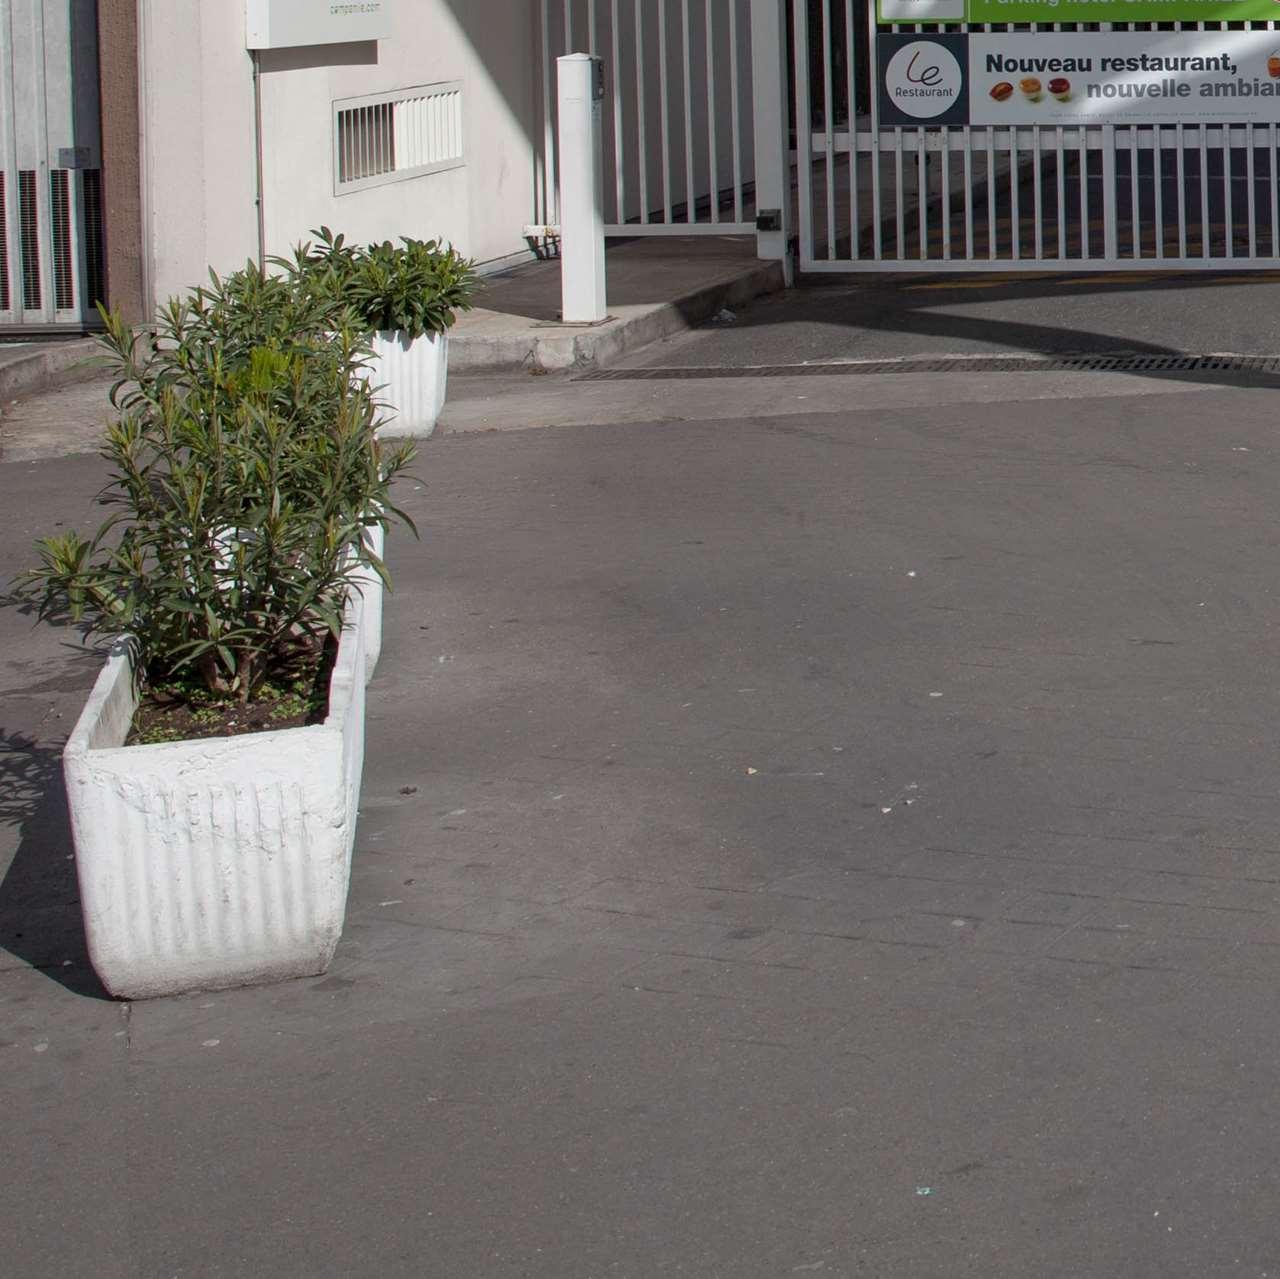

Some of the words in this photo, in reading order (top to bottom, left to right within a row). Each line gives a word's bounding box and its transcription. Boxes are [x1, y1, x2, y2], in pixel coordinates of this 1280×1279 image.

[985, 53, 1093, 73] Nouveau
[1100, 52, 1238, 76] restaurant,
[895, 86, 953, 99] Restaurant
[1086, 79, 1192, 98] nouvelle
